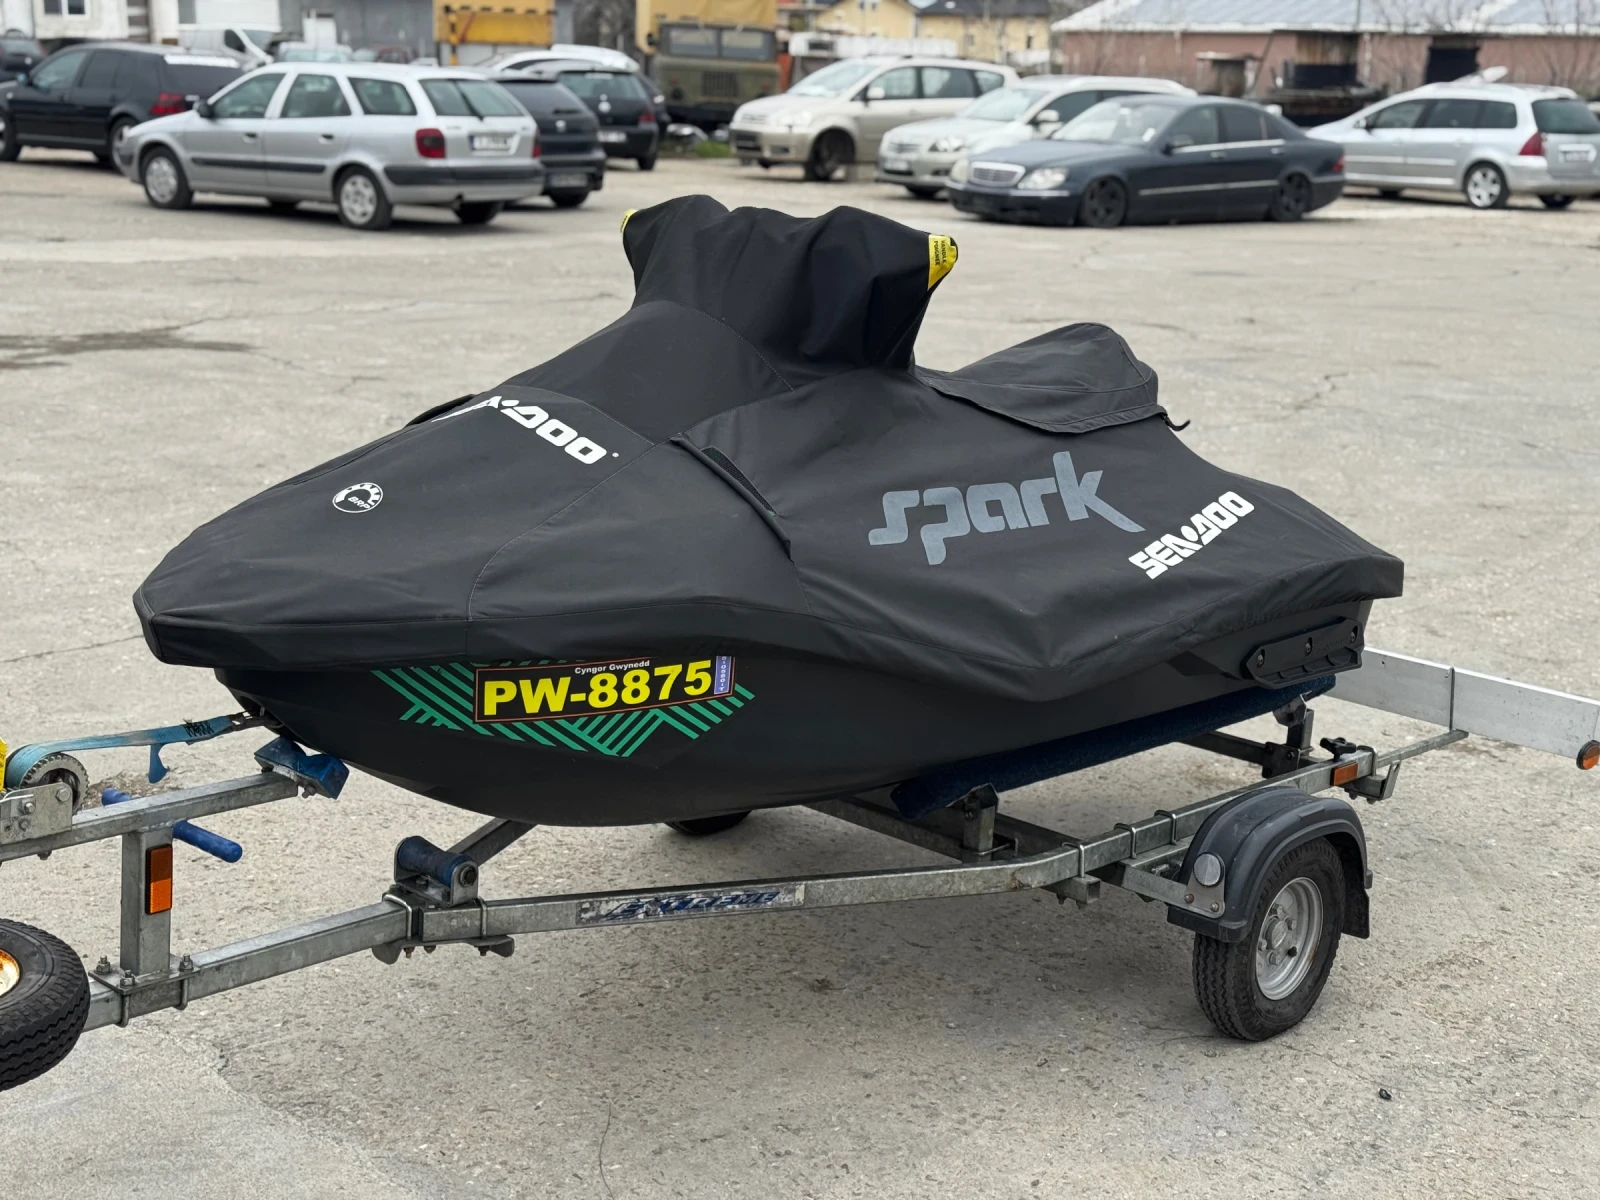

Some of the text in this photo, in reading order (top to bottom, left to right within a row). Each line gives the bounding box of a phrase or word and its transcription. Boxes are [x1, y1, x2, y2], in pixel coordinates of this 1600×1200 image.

[347, 496, 371, 509] BRP
[575, 660, 650, 675] Cyngor Gwynedd
[484, 659, 712, 716] PW-8875
